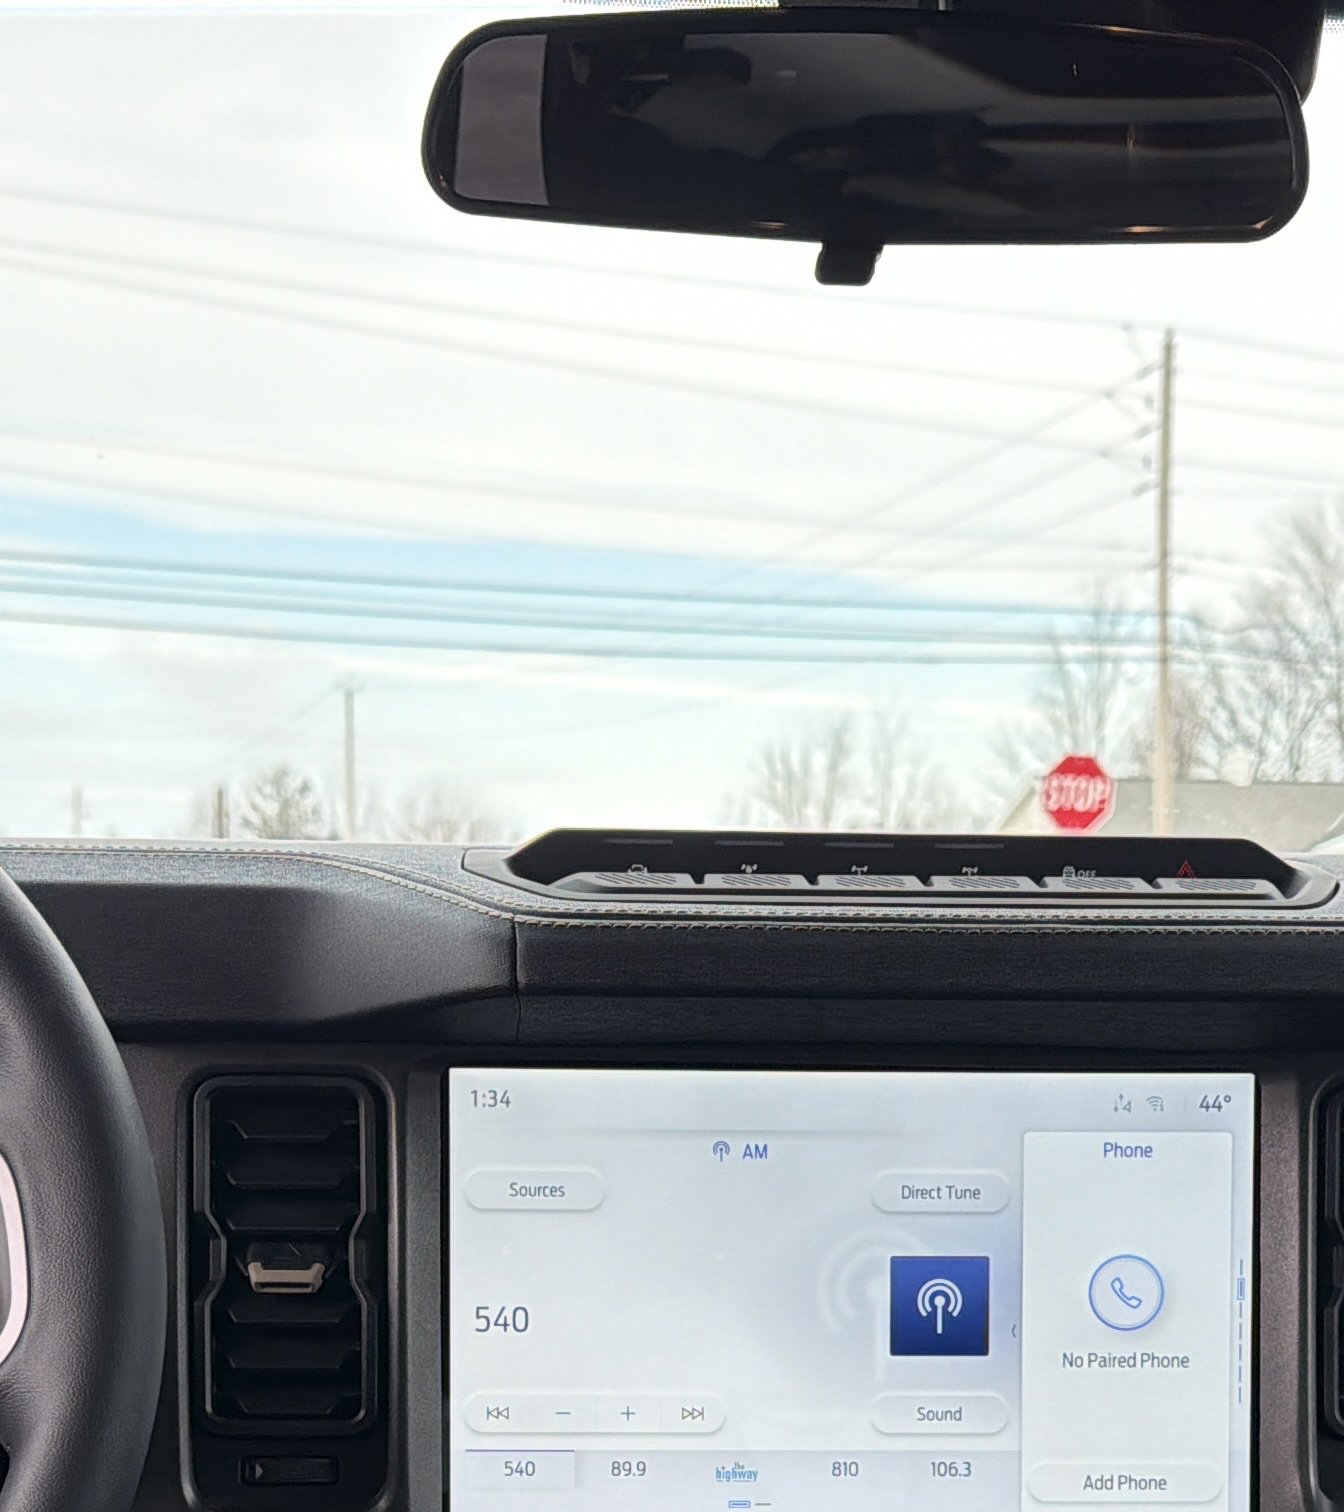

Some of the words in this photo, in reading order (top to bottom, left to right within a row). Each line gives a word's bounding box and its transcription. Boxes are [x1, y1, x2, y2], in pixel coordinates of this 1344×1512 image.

[1044, 773, 1107, 812] STOP
[1078, 870, 1096, 878] OFF
[470, 1089, 512, 1108] 1:34
[742, 1143, 768, 1160] AM
[1103, 1142, 1153, 1159] Phone
[509, 1181, 565, 1198] Sources
[900, 1184, 943, 1200] Direct
[946, 1185, 981, 1200] Tune
[474, 1305, 529, 1333] 540
[1061, 1352, 1083, 1368] No
[1087, 1352, 1137, 1369] Paired
[1140, 1353, 1190, 1369] Phone
[916, 1406, 962, 1422] Sound
[503, 1460, 536, 1478] 540
[610, 1461, 647, 1478] 89.9
[715, 1464, 759, 1483] highway
[831, 1461, 859, 1477] 810
[930, 1461, 972, 1478] 106.3
[1083, 1475, 1114, 1491] Add
[1117, 1475, 1167, 1491] Phone
